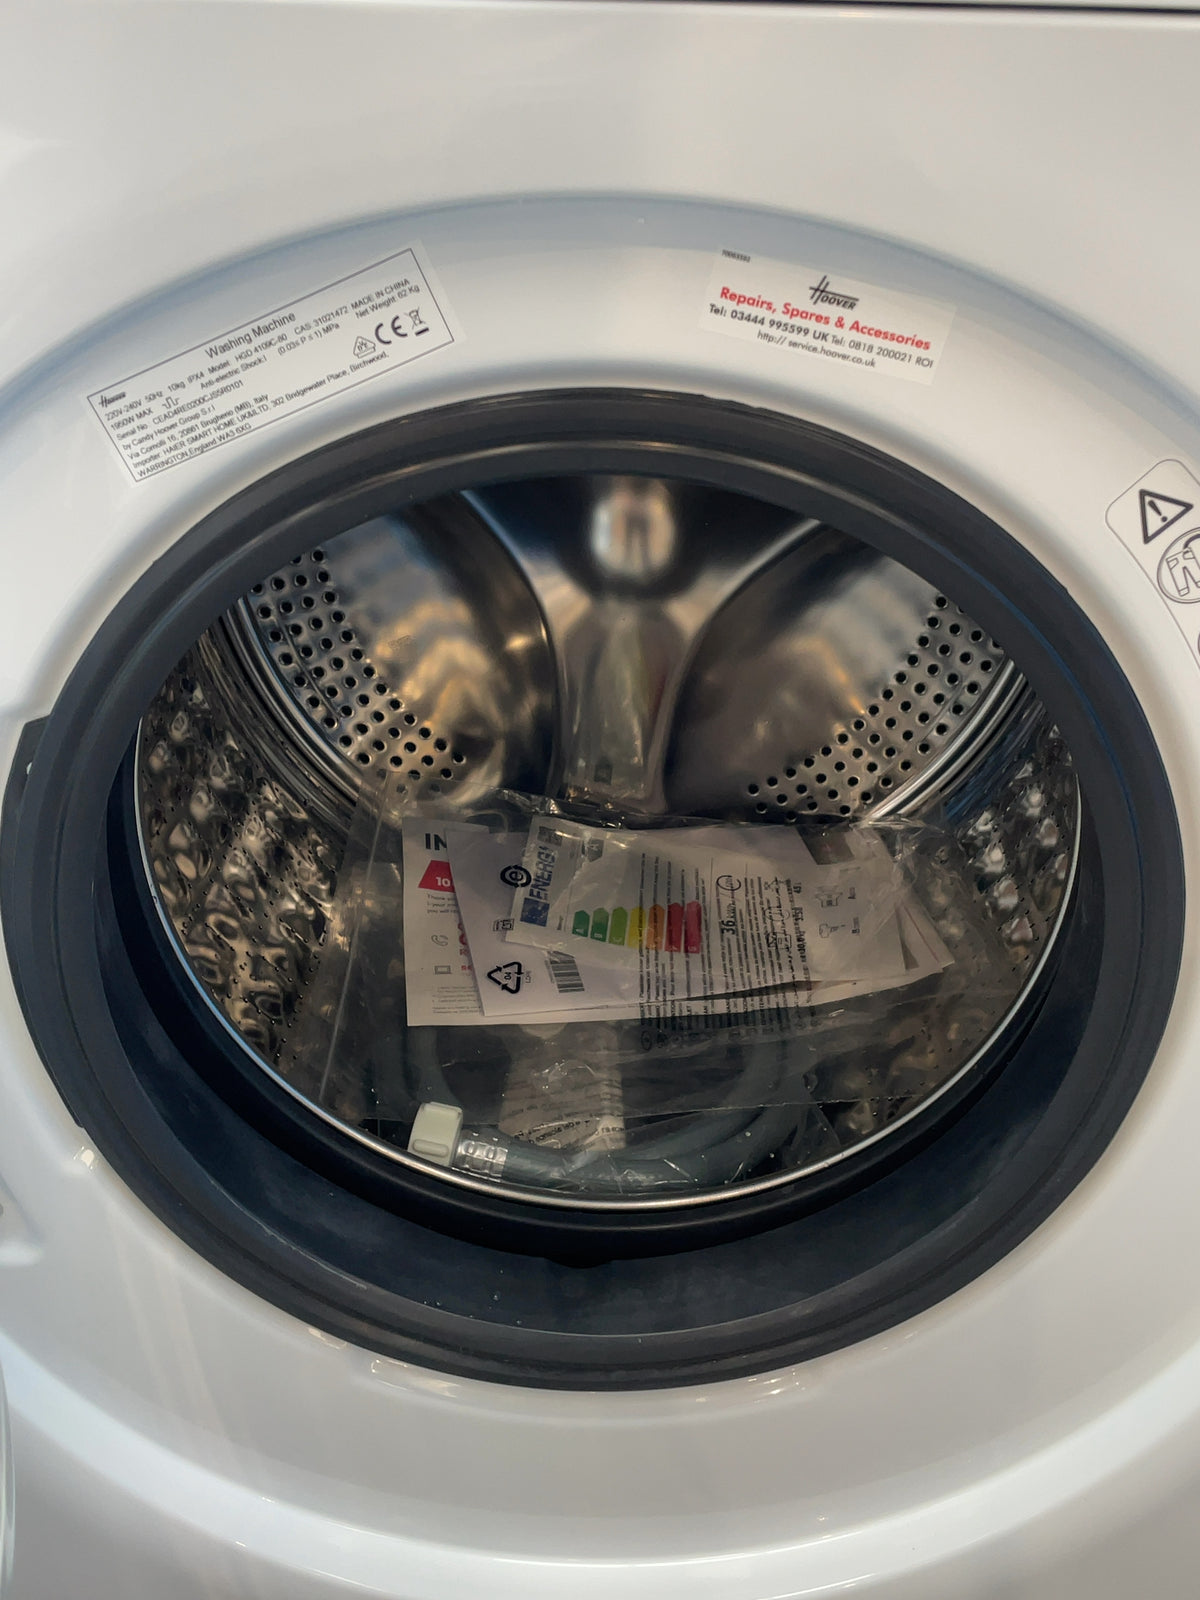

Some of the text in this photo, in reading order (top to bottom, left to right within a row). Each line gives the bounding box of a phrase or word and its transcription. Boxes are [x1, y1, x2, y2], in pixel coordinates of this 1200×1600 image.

[350, 295, 372, 309] MADE
[384, 278, 410, 294] CHINA
[808, 275, 859, 310] HOOVER
[355, 308, 369, 318] Net
[720, 286, 930, 350] Repairs, Spares & Accessories
[204, 313, 295, 358] Washing Machine
[709, 303, 933, 368] Tel: 03444 995599 UK Tel: 0818 200021 ROI
[131, 433, 154, 445] Candy
[178, 412, 200, 425] Group
[135, 407, 153, 419] MAX
[162, 440, 186, 455] HAIER
[186, 428, 212, 444] SMART
[213, 418, 234, 432] HOME
[719, 919, 736, 935] 36
